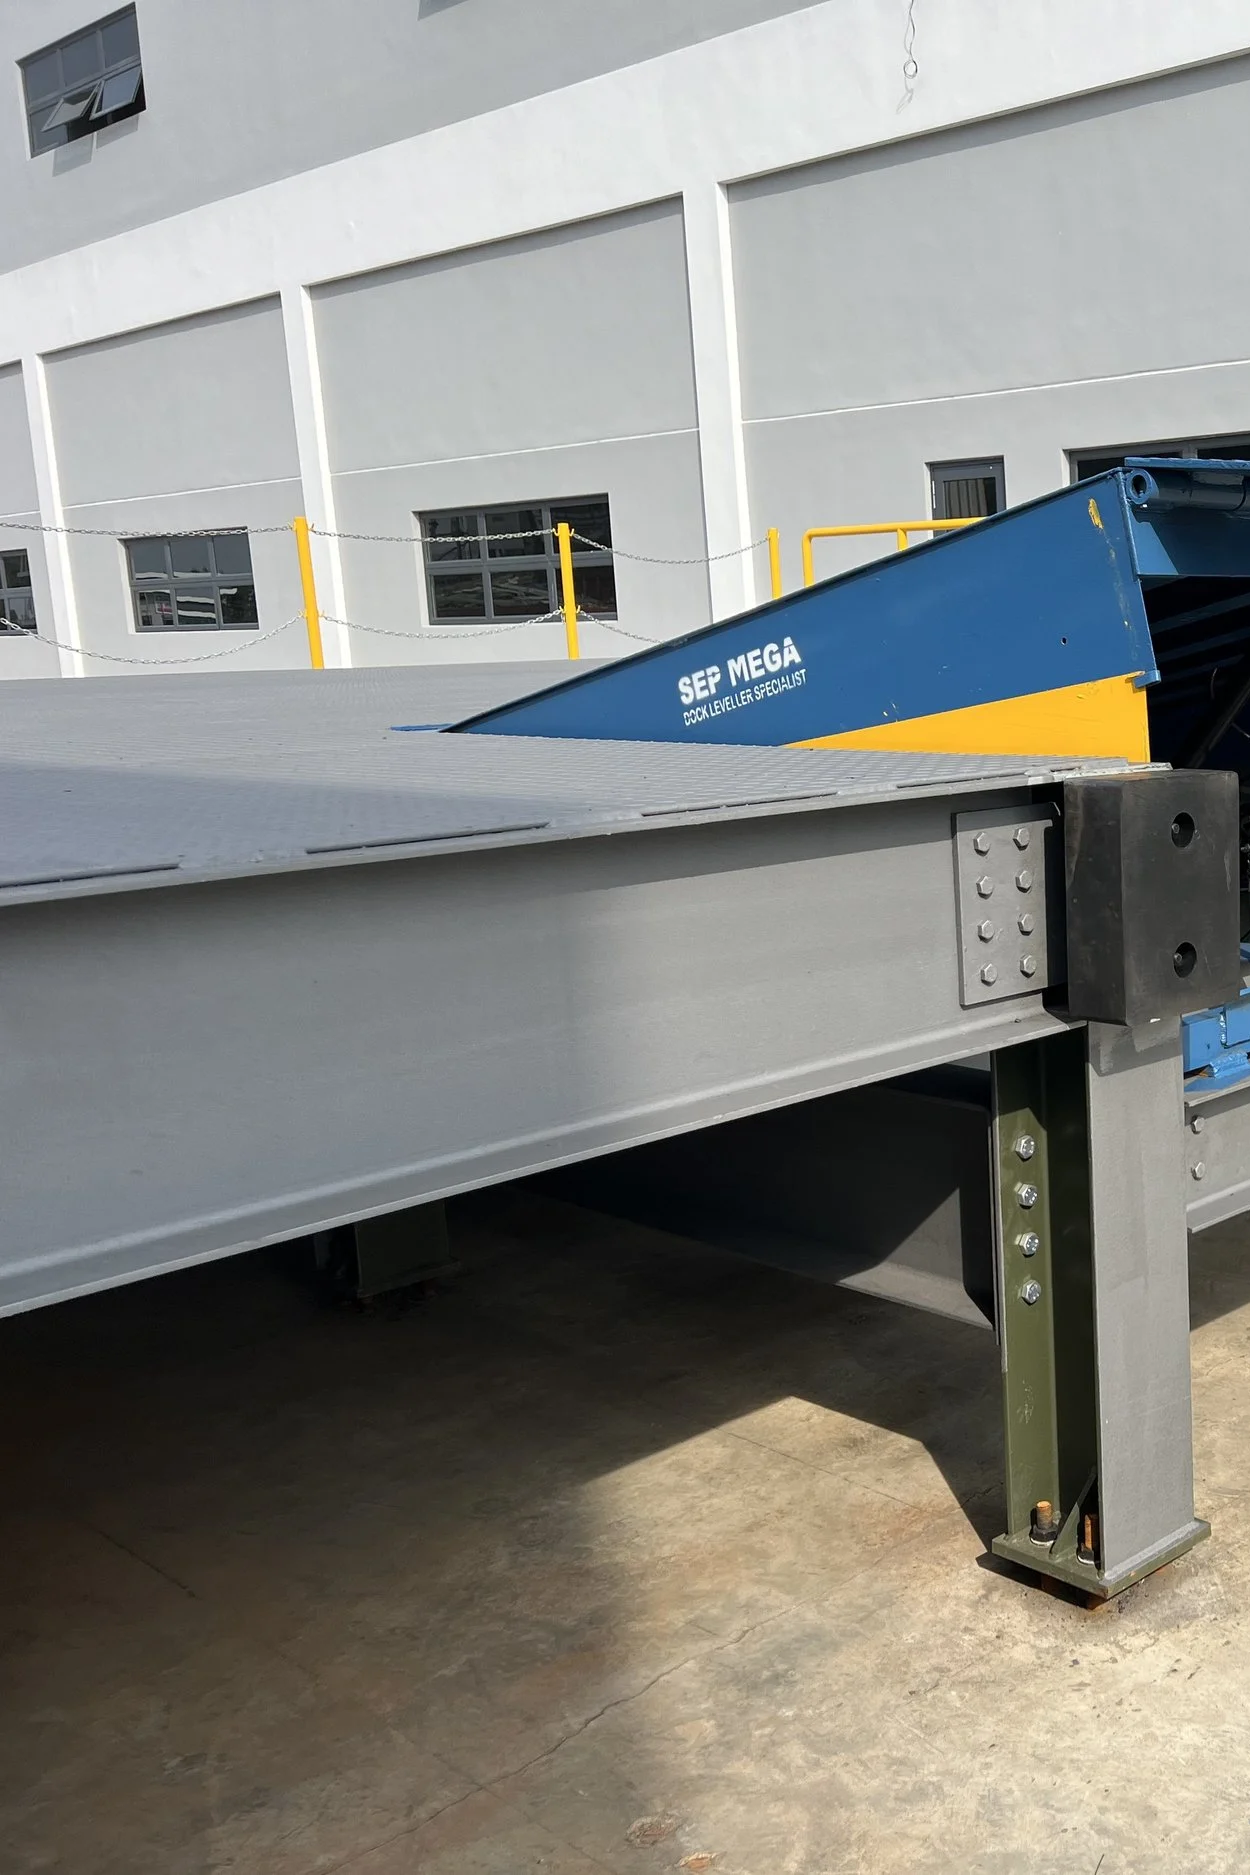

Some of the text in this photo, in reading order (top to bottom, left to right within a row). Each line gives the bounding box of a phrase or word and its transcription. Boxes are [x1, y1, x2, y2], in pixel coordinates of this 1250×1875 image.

[678, 636, 802, 705] SEP MEGA
[683, 668, 807, 726] DOCK LEVELLER SPECIALIST
